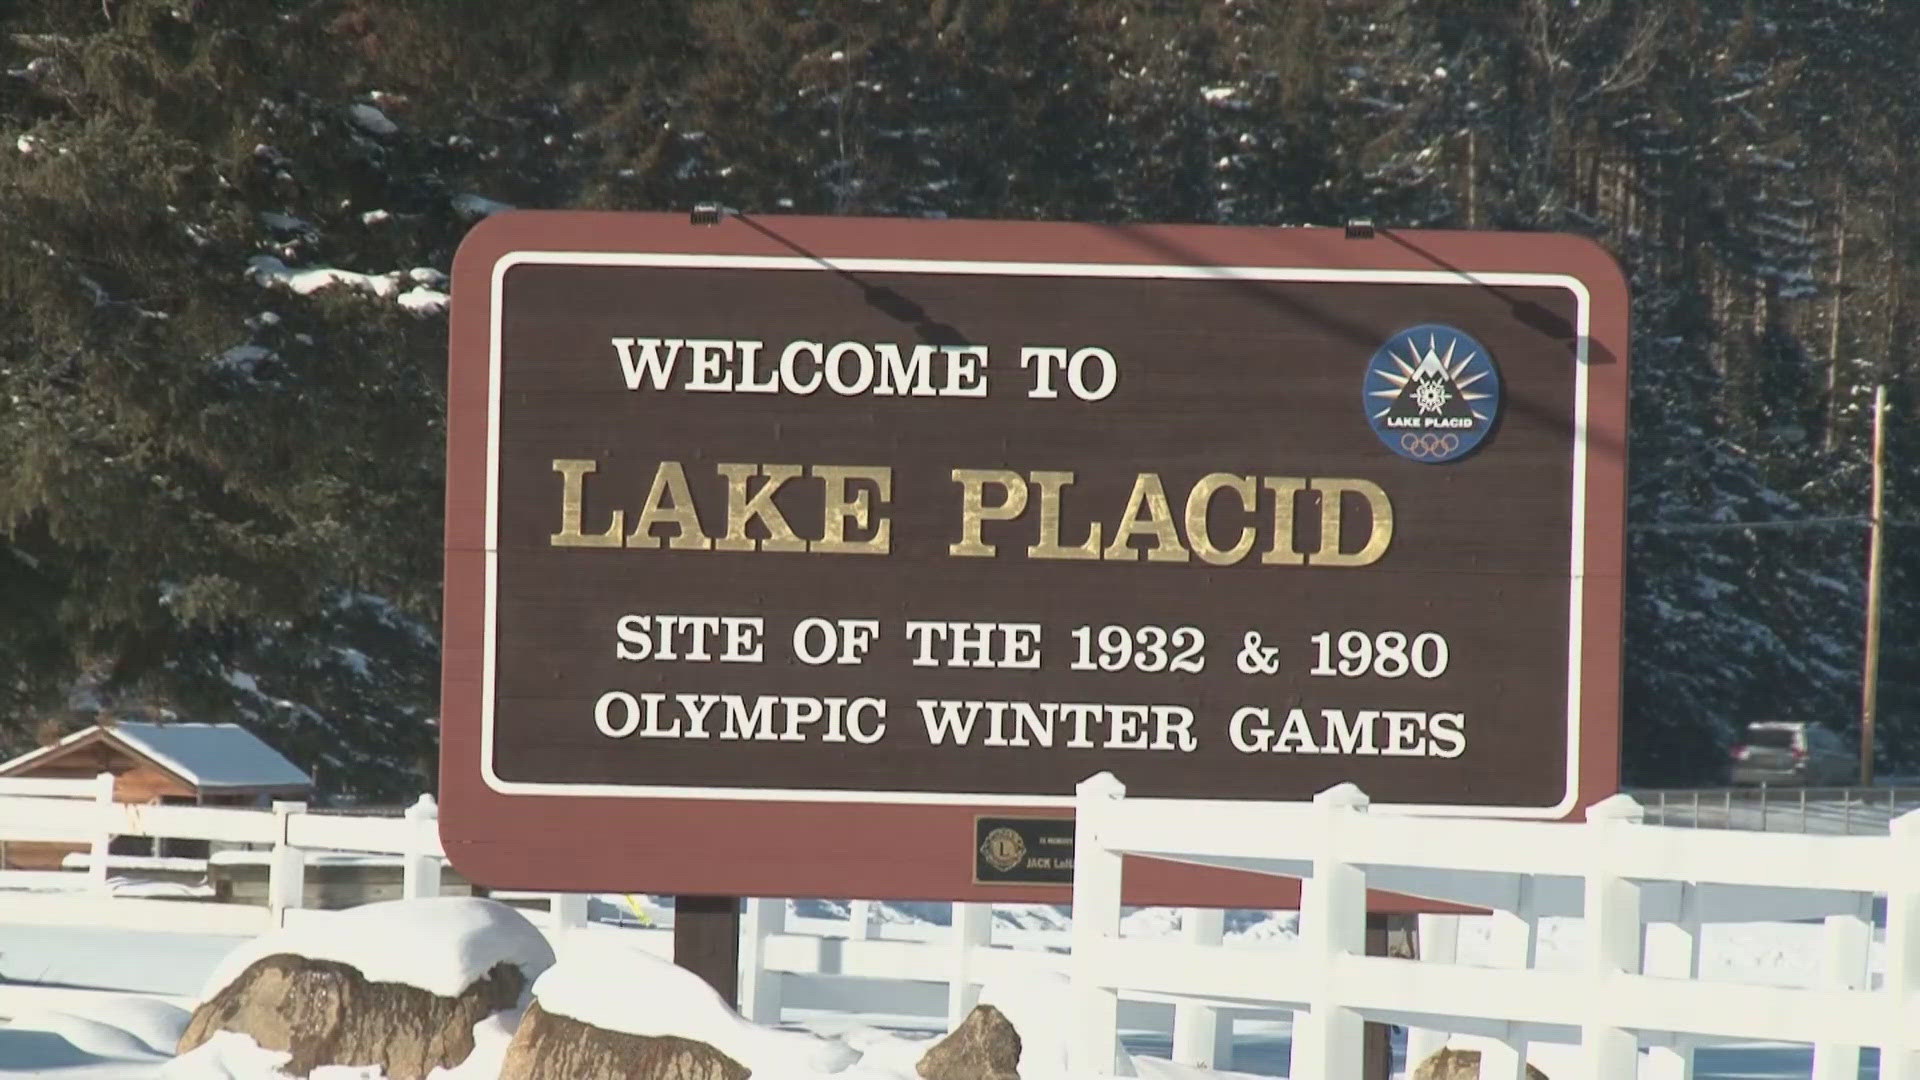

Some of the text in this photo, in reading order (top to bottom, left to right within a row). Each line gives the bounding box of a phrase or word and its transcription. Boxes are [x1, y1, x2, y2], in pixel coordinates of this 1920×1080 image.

[611, 338, 1117, 401] WELCOME TO
[1386, 416, 1474, 429] LAKE PLACID
[550, 459, 1393, 566] LAKE PLACID
[616, 614, 1449, 679] SITE OF THE 1932 & 1980
[594, 691, 1466, 759] OLYMPIC WINTER GAMES
[1026, 857, 1051, 869] JACK
